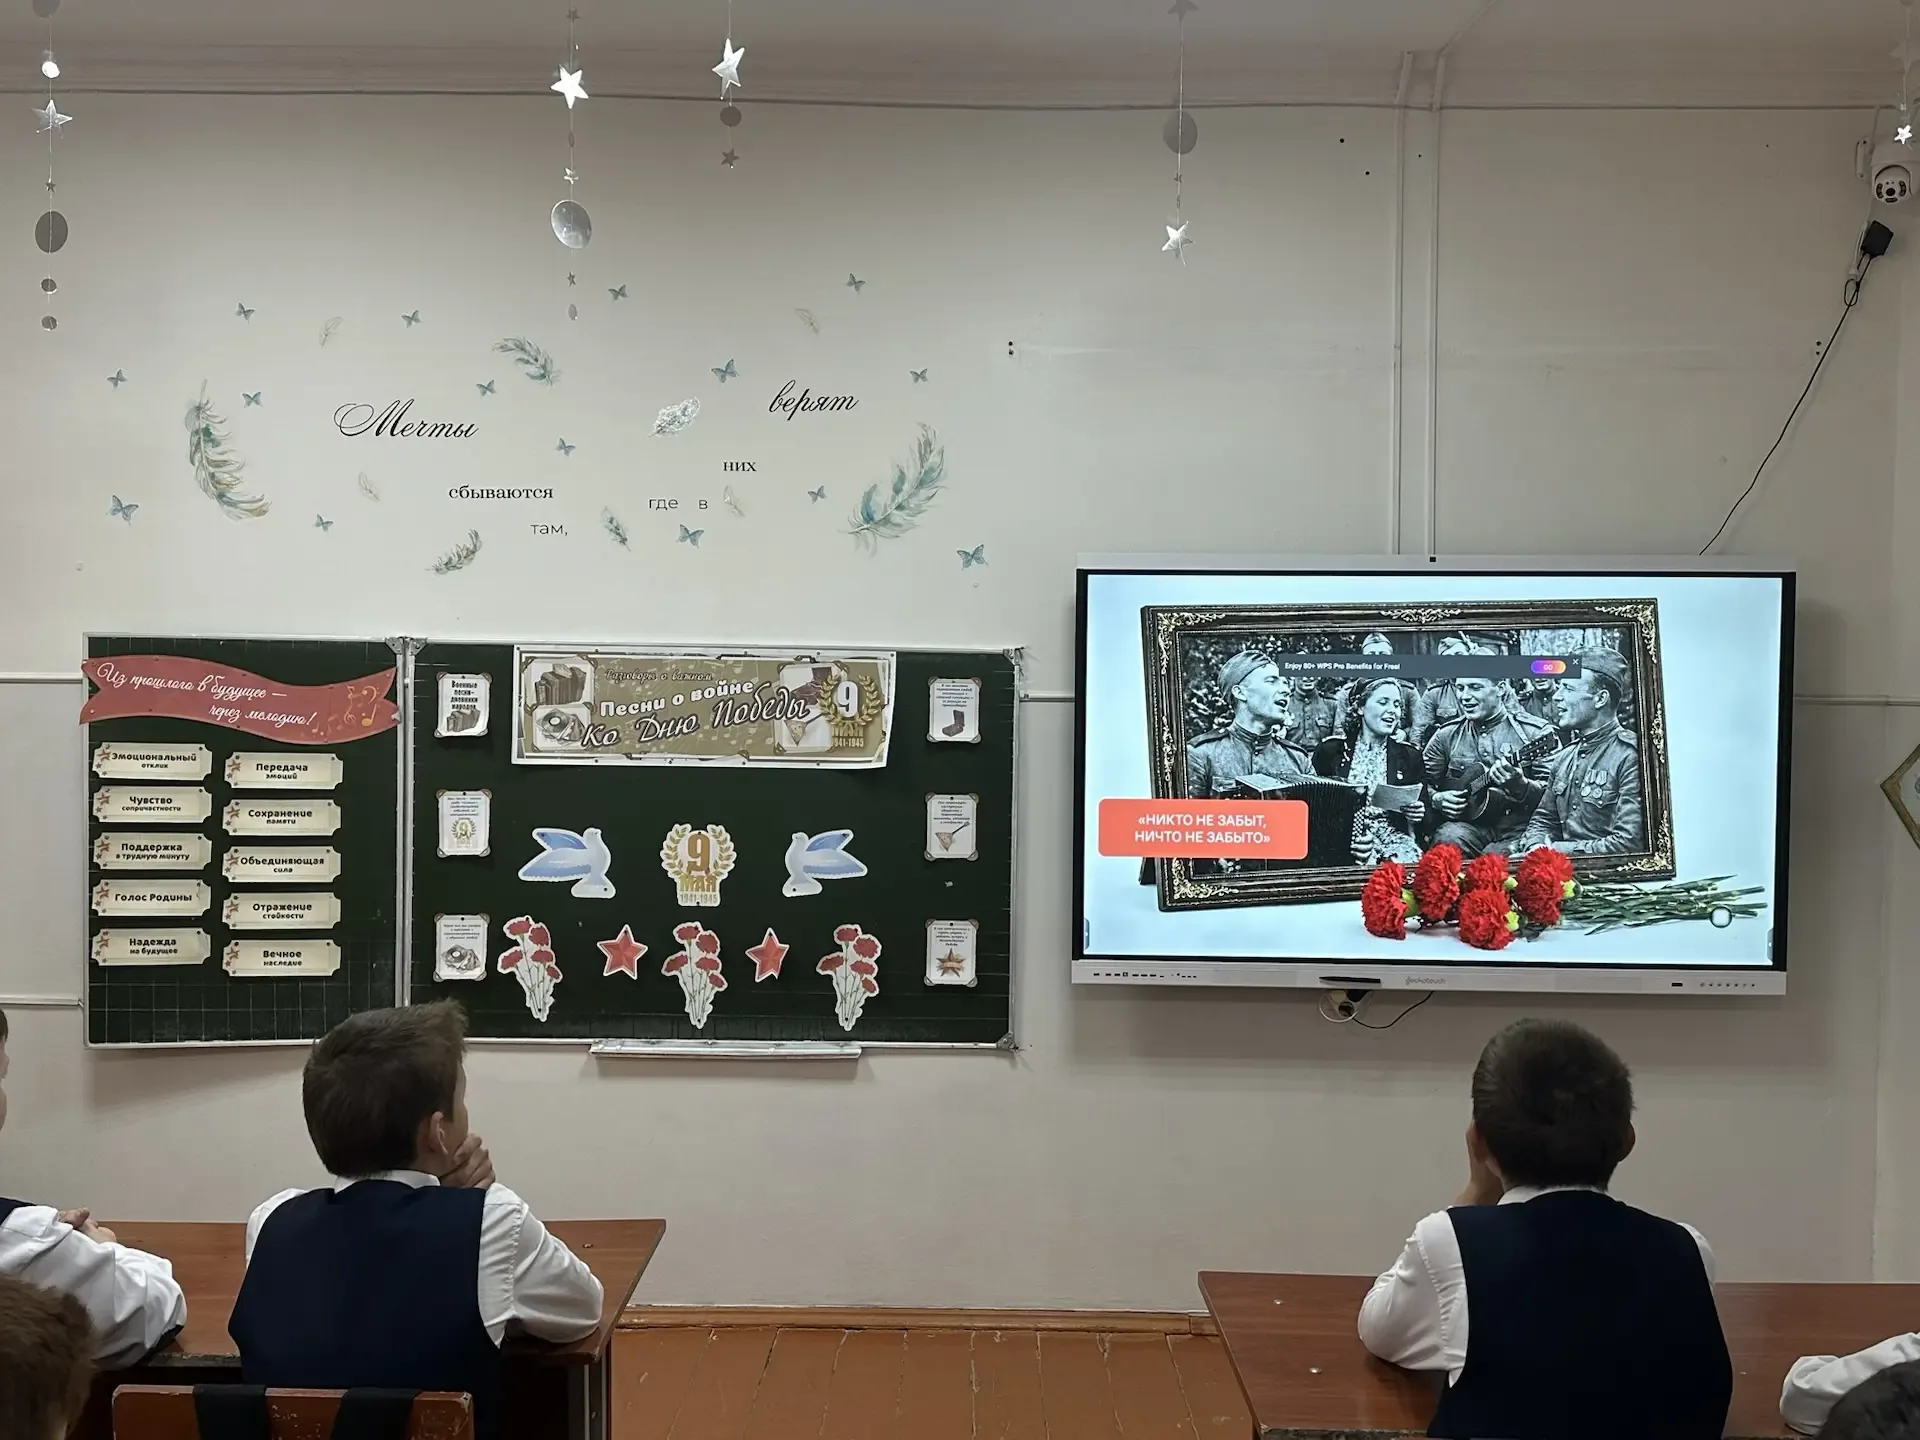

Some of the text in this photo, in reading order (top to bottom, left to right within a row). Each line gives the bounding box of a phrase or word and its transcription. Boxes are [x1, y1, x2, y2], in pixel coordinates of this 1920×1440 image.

[768, 380, 860, 421] верят
[333, 398, 480, 439] Мечты
[723, 460, 757, 472] них
[448, 484, 554, 501] сбываются
[648, 498, 708, 512] где в
[530, 522, 568, 537] там,
[1284, 662, 1303, 671] Enjoy
[1316, 662, 1333, 670] WPS
[1333, 662, 1345, 670] Pro
[1345, 662, 1372, 670] Benefits
[1373, 662, 1383, 670] for
[1383, 662, 1401, 670] Free!
[97, 662, 128, 689] Из
[129, 675, 195, 690] прошлого
[197, 674, 214, 692] в
[210, 675, 267, 702] будущее
[605, 669, 714, 685] Разговоры о важном
[600, 680, 754, 717] Песни о войне
[837, 680, 859, 718] 9
[208, 704, 318, 729] через мелодию!
[580, 681, 811, 747] Ко Дню Победы
[831, 737, 864, 748] 1941-1945
[111, 751, 197, 763] Эмоциональный
[141, 762, 169, 770] отклик
[255, 762, 309, 774] Передача
[265, 772, 298, 780] эмоций
[129, 796, 173, 805] Чувство
[121, 805, 181, 813] сопричастности
[248, 809, 313, 818] Сохранение
[1138, 813, 1267, 828] «НИКТО НЕ ЗАБЫТ,
[1134, 830, 1271, 844] НИЧТО НЕ ЗАБЫТО»
[121, 843, 183, 853] Поддержка
[687, 833, 711, 872] 9
[122, 853, 158, 862] трудную
[159, 853, 190, 862] минуту
[240, 856, 325, 867] Объединяющая
[273, 866, 293, 874] сила
[679, 874, 718, 893] МАЯ
[114, 892, 193, 903] Голос Родины
[680, 894, 718, 904] 1941-1945
[252, 902, 312, 912] Отражение
[262, 912, 304, 920] стойкости
[129, 937, 177, 947] Надежда
[141, 946, 178, 956] будущее
[263, 949, 302, 959] Вечное
[263, 959, 303, 967] наследие
